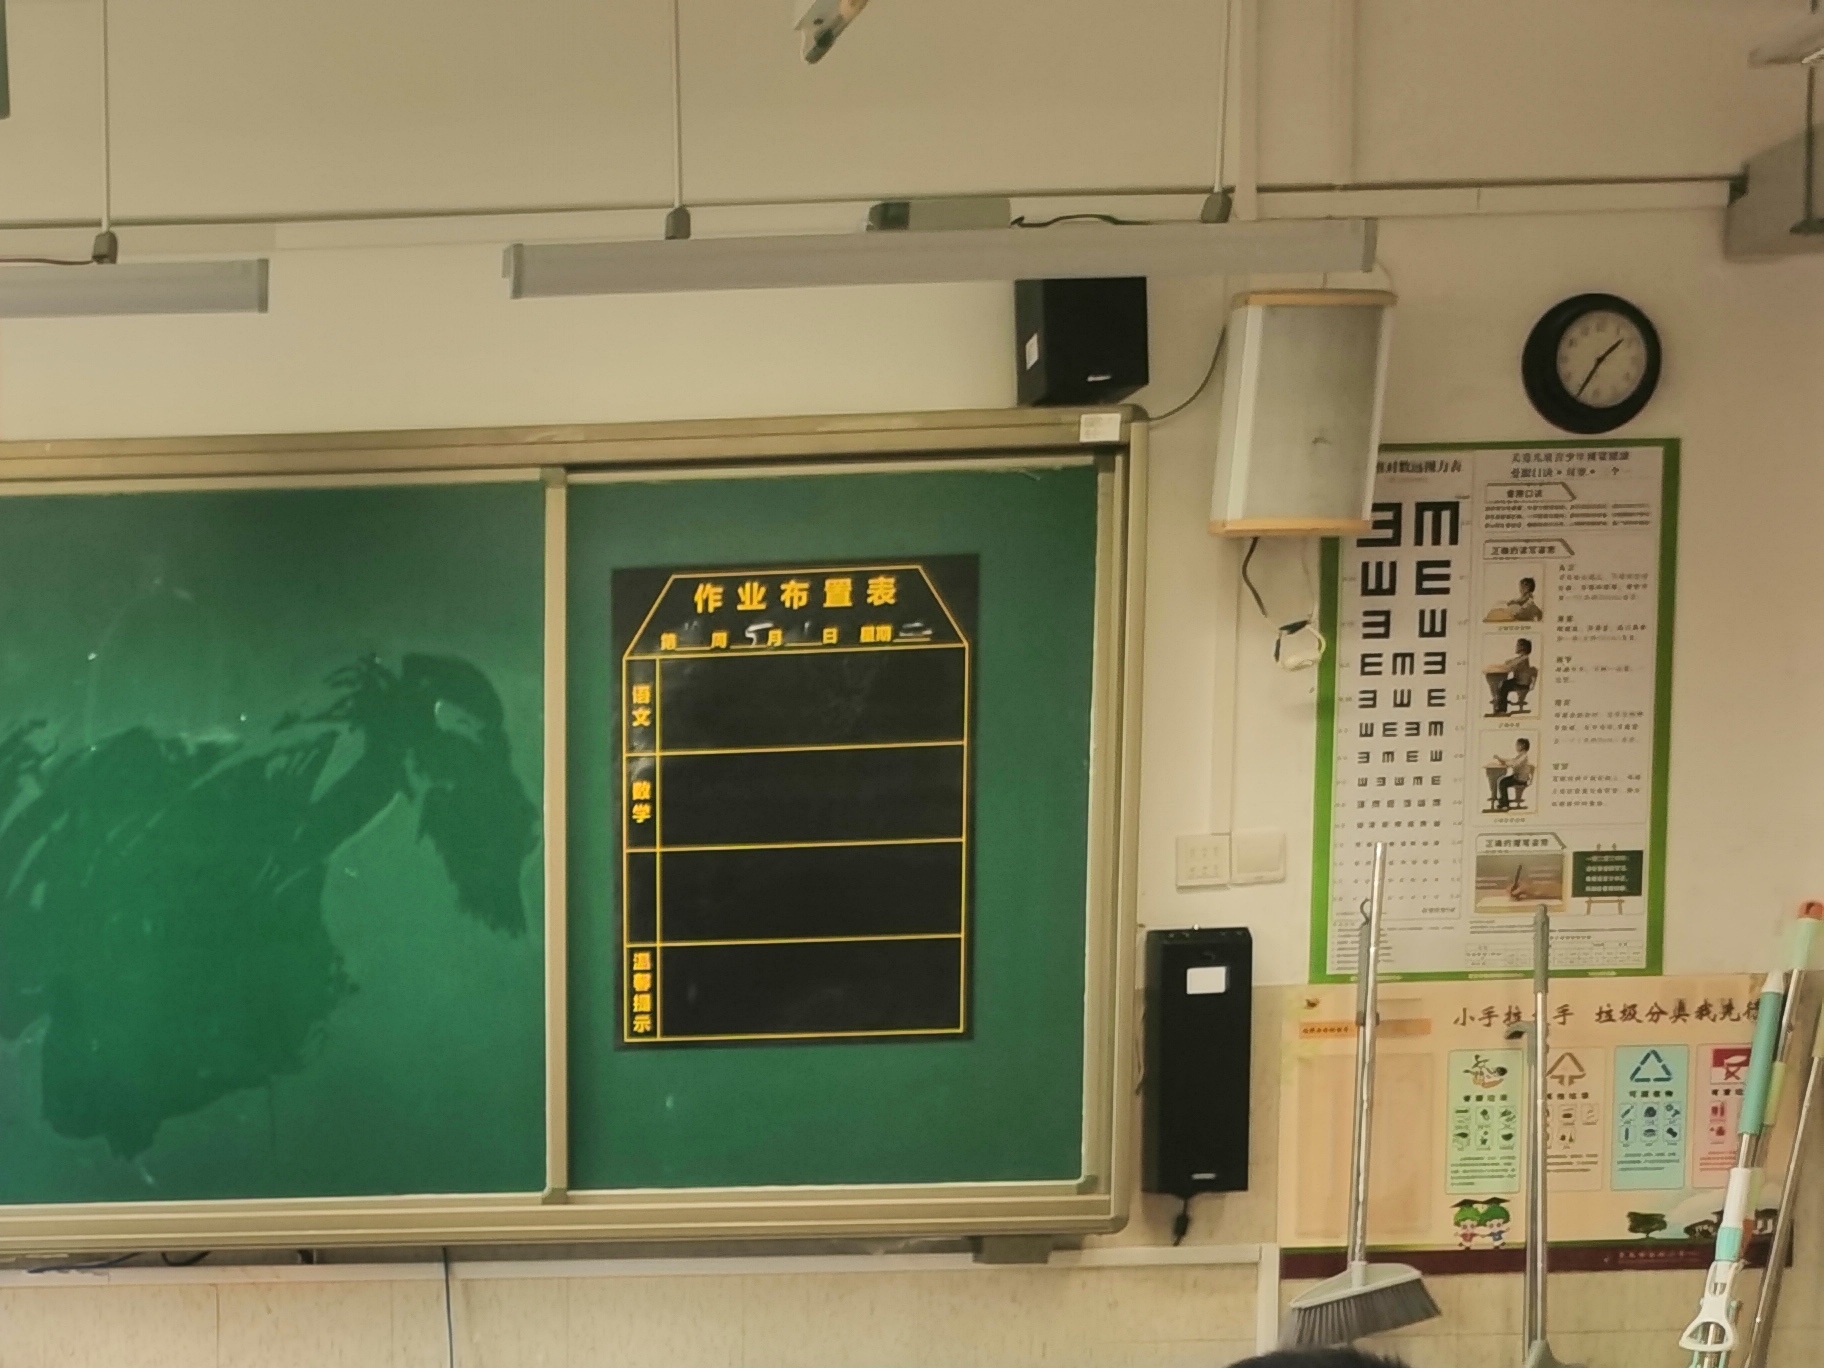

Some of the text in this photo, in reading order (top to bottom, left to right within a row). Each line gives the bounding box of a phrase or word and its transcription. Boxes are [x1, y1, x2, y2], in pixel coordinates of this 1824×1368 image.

[693, 577, 897, 614] 作业布置表
[822, 628, 839, 645] 日
[632, 684, 651, 727] 语文
[632, 781, 651, 823] 数学
[632, 952, 651, 1034] 温馨提示
[1453, 1003, 1574, 1027] 小手拉手
